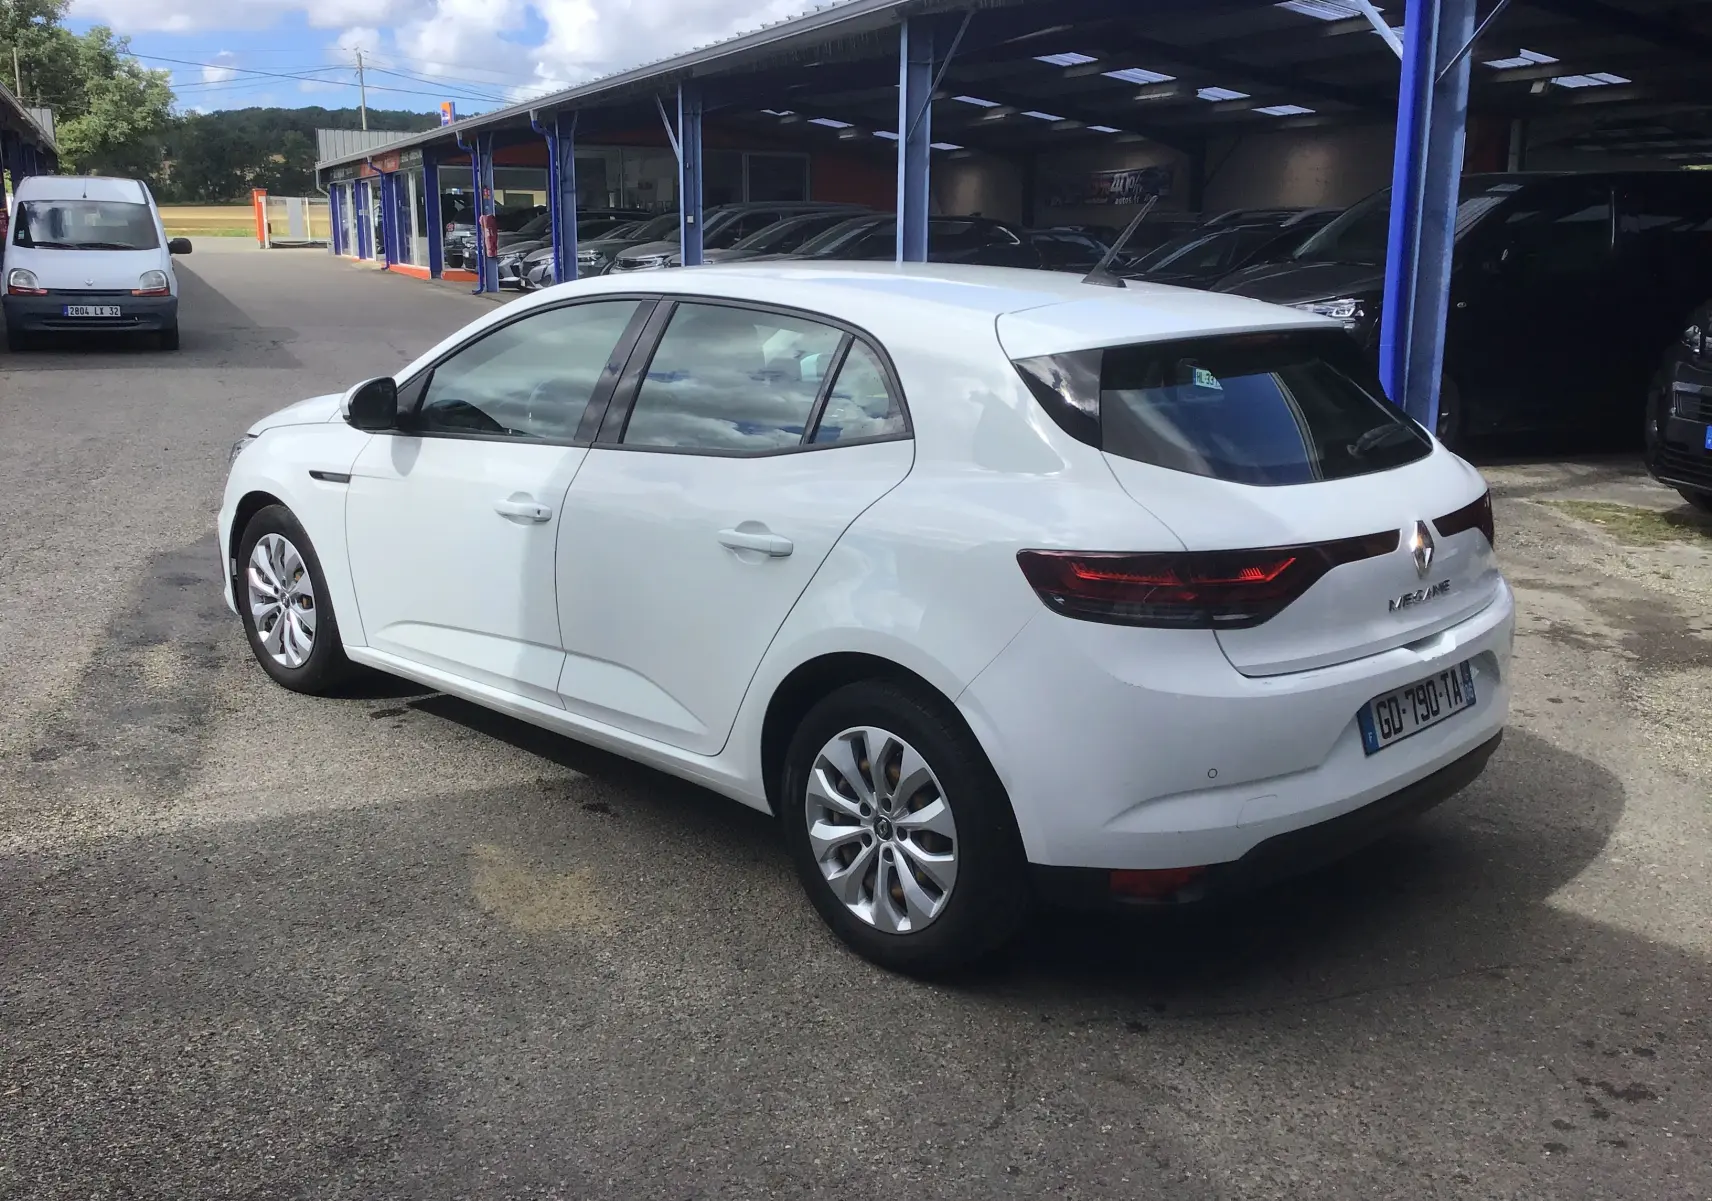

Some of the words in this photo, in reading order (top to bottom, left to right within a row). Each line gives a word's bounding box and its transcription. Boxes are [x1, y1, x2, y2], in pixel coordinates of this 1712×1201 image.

[69, 306, 89, 316] 2804
[94, 306, 104, 316] LX
[109, 306, 119, 316] 32
[1388, 580, 1450, 612] MEGANE
[1376, 668, 1463, 739] GD-790-TA
